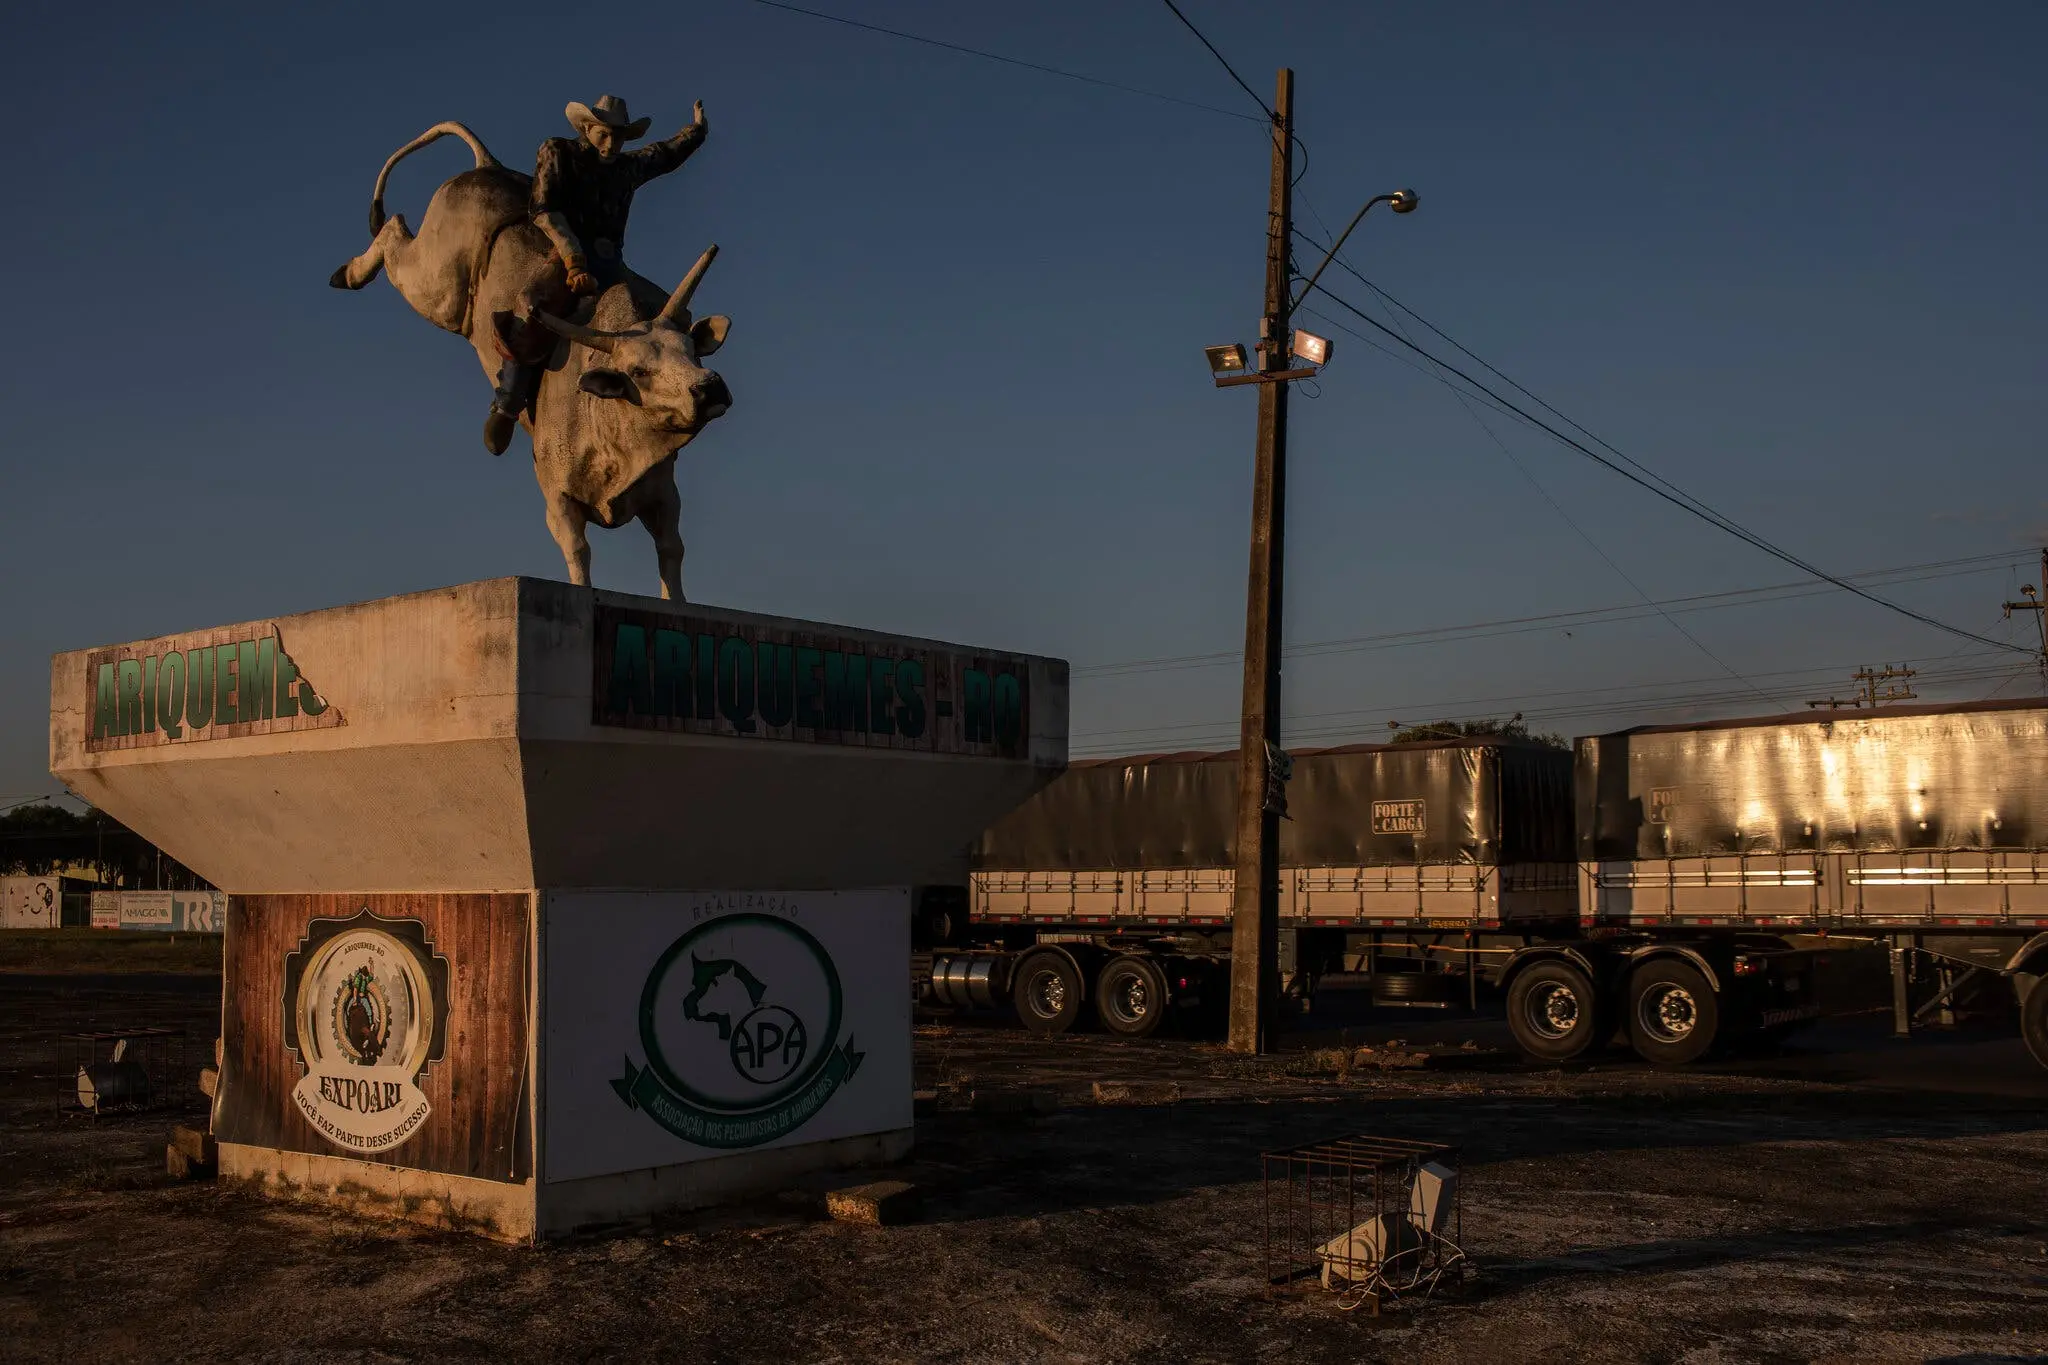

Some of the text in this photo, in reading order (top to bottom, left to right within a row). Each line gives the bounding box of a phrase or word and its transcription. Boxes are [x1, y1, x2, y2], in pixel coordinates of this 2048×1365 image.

[609, 622, 925, 738] ARIQUEMES
[963, 667, 1022, 749] RO
[1374, 804, 1415, 818] FORTE
[1382, 817, 1423, 832] CARGA
[731, 1021, 807, 1069] APA
[296, 1089, 428, 1148] VOCÊ FAZ PARTE DESSE SUCESSO
[318, 1075, 403, 1114] EXPOARI
[651, 1074, 834, 1141] ASSOCIAÇÃO DOS PECUARISTAS DE ARIQUEMES
